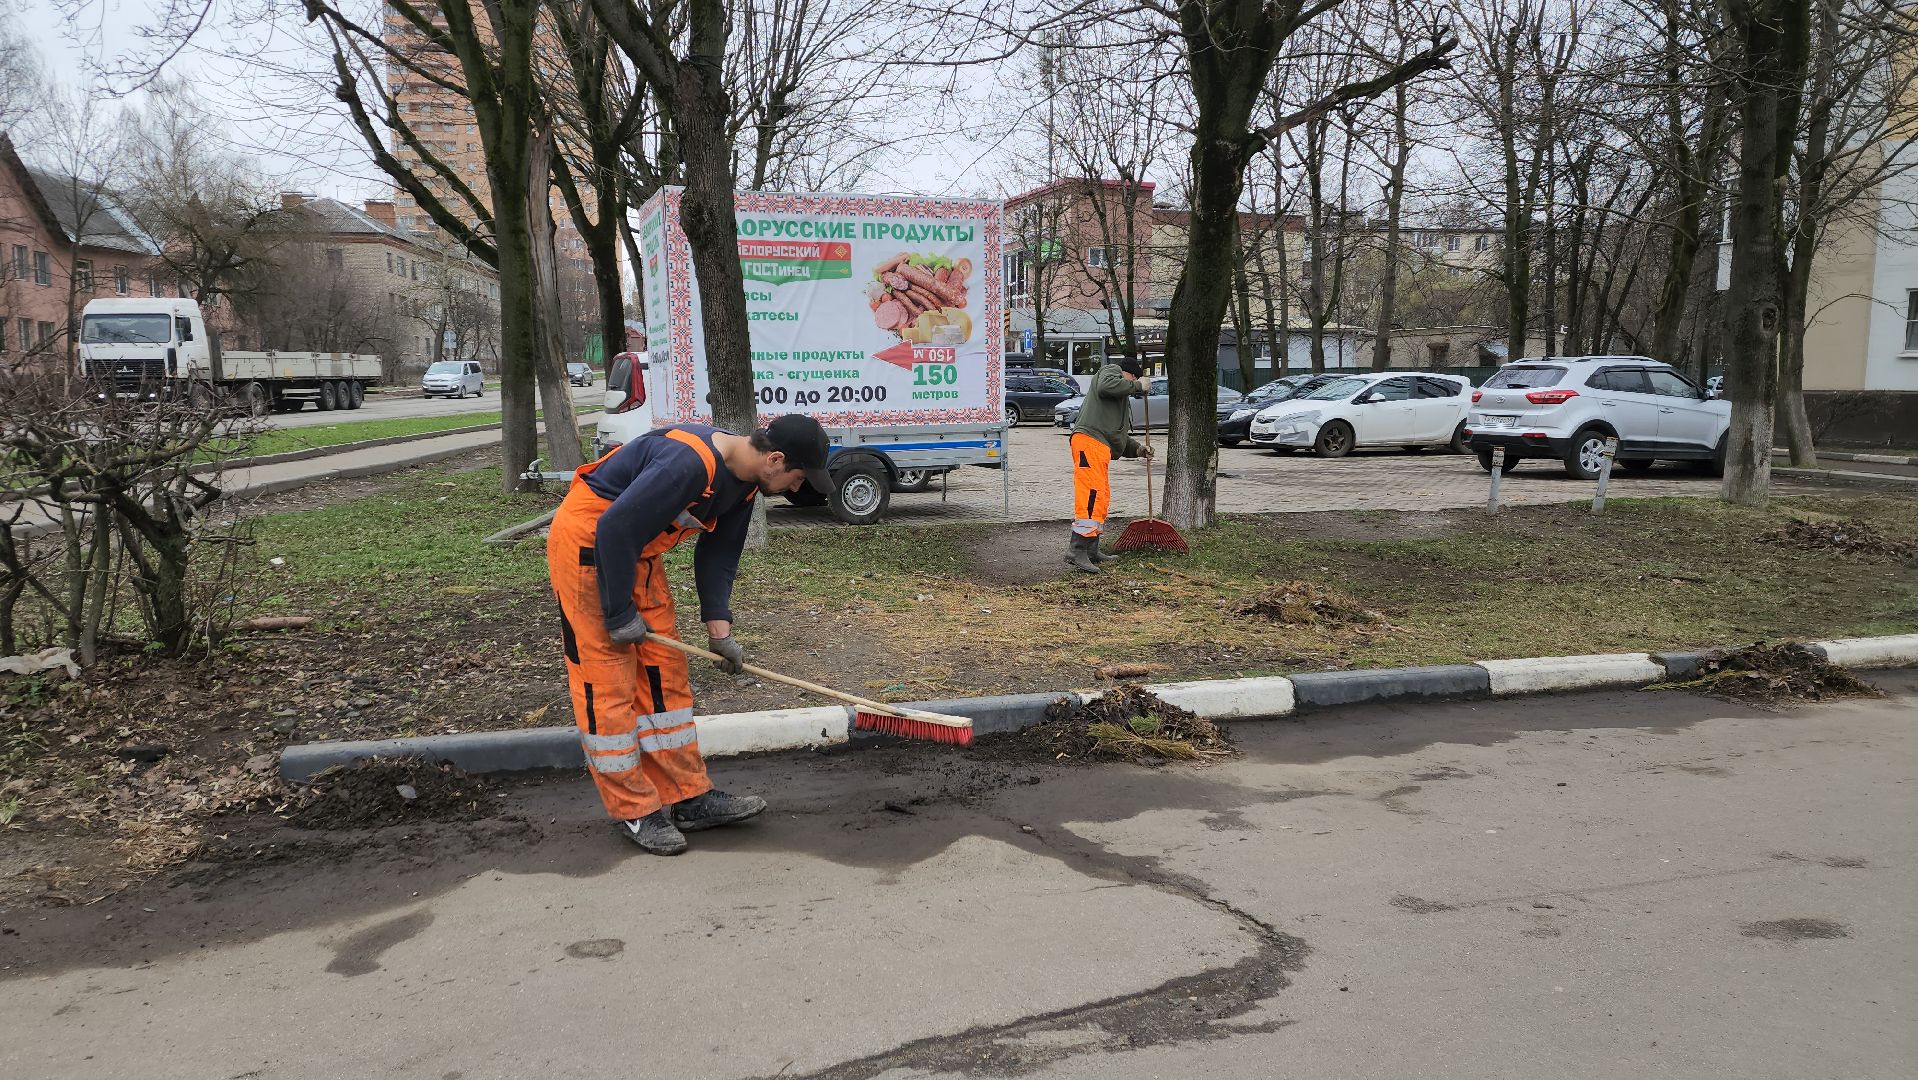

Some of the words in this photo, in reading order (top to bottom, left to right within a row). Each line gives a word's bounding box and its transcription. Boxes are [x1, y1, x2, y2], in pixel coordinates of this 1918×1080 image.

[862, 222, 974, 244] ПРОДУКТЫ
[744, 290, 772, 302] асы
[792, 350, 865, 363] продукты
[787, 369, 860, 382] сгущенка
[913, 364, 958, 386] 150
[754, 386, 788, 405] :00
[794, 390, 821, 407] до
[827, 385, 887, 403] 20:00
[912, 390, 959, 400] метров
